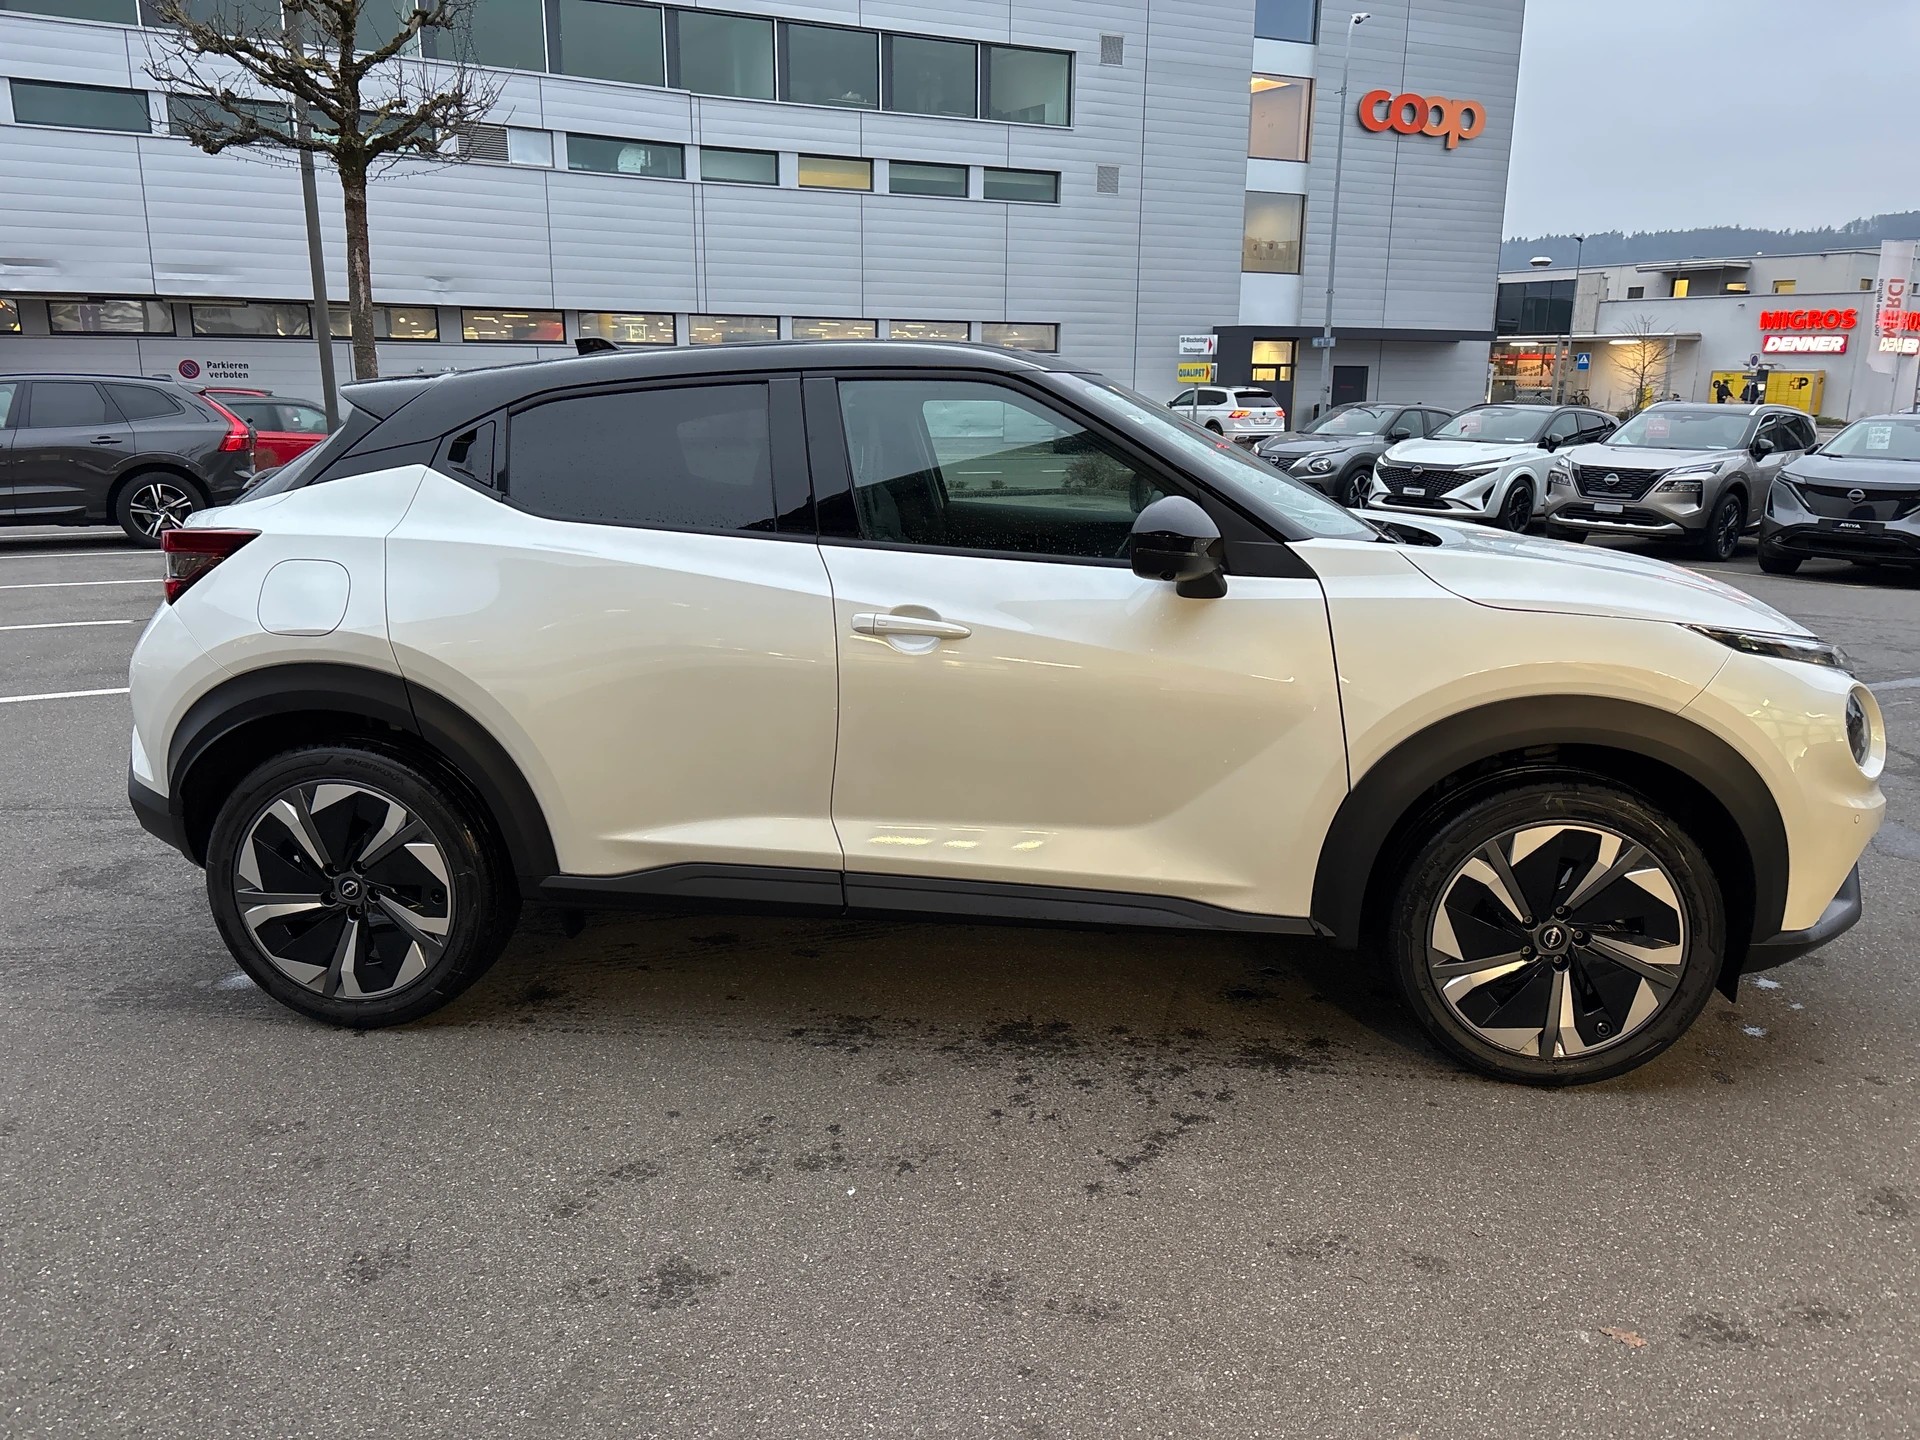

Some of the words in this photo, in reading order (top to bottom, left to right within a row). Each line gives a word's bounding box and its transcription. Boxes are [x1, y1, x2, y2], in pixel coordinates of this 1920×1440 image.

[1359, 89, 1486, 149] coop
[1759, 309, 1857, 330] MIGROS
[1764, 336, 1844, 352] DENNER
[206, 361, 249, 369] Parkieren
[209, 371, 249, 379] verboten
[1178, 368, 1205, 378] QUALIPET
